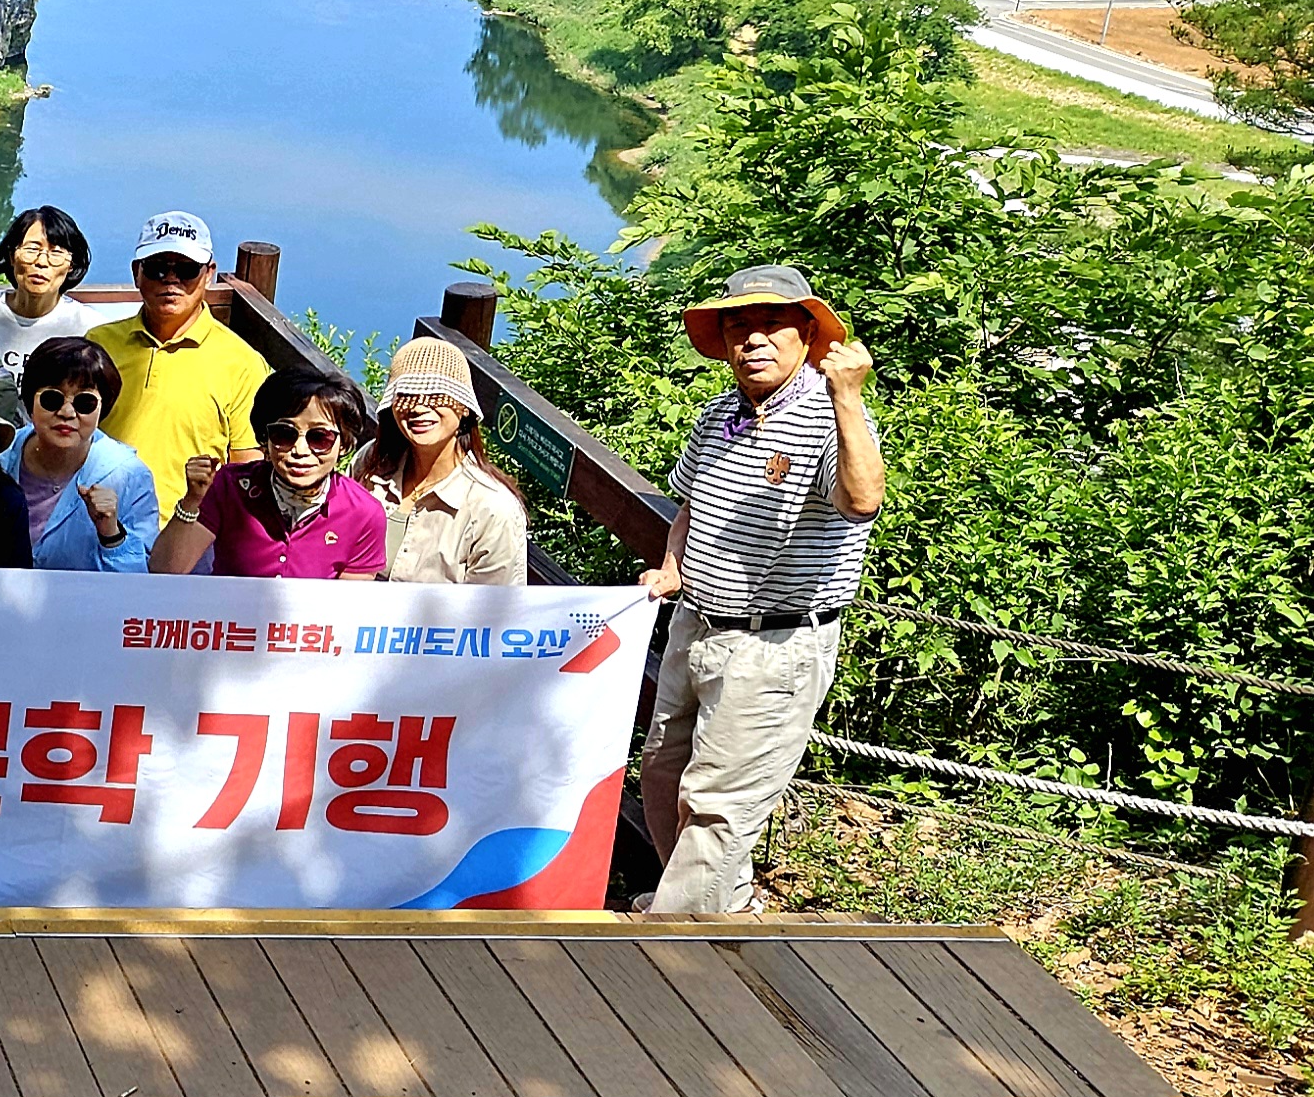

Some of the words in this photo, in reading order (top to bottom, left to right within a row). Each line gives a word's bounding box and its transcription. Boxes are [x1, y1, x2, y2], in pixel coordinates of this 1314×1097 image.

[121, 617, 258, 652] 함께하는
[265, 621, 343, 657] 변화,
[354, 624, 491, 659] 미래도시
[500, 628, 572, 660] 오산
[192, 711, 458, 837] 기행
